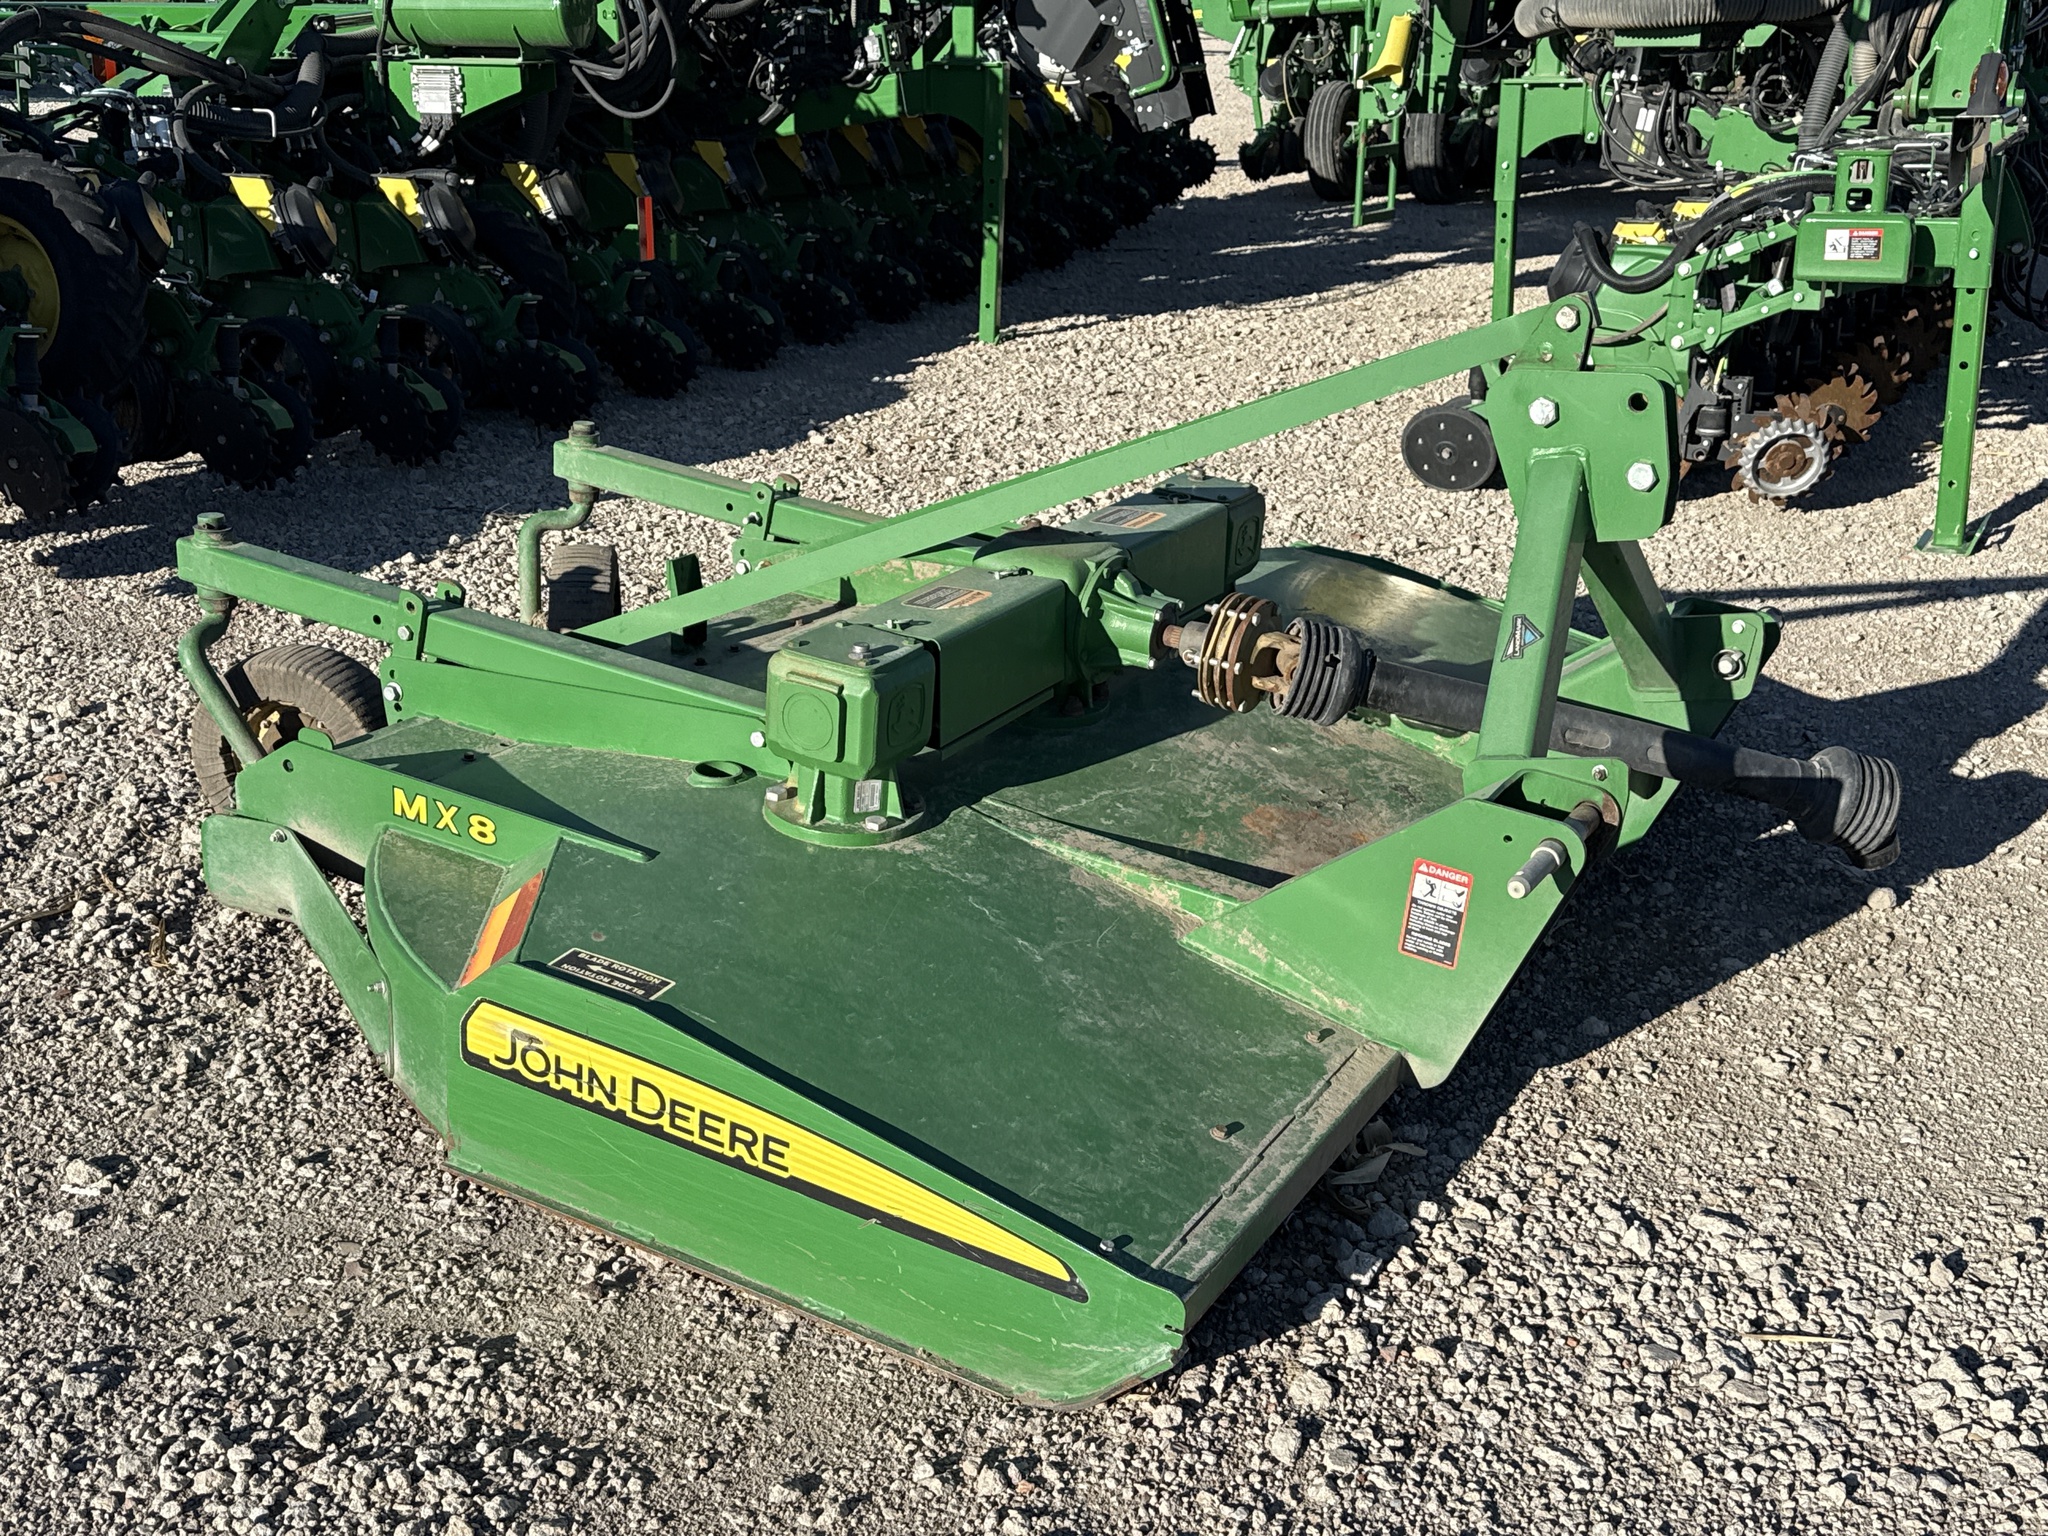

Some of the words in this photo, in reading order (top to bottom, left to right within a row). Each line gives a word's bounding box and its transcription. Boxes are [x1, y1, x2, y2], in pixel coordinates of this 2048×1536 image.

[1514, 617, 1522, 656] LANDMARK
[392, 785, 497, 846] MX8
[1428, 865, 1469, 884] DANGER
[561, 963, 612, 983] ROTATION
[577, 952, 610, 967] BLADE
[611, 963, 662, 984] ROTATION
[613, 979, 646, 995] BLADE
[493, 1028, 618, 1108] JOHN
[631, 1076, 790, 1174] DEERE
